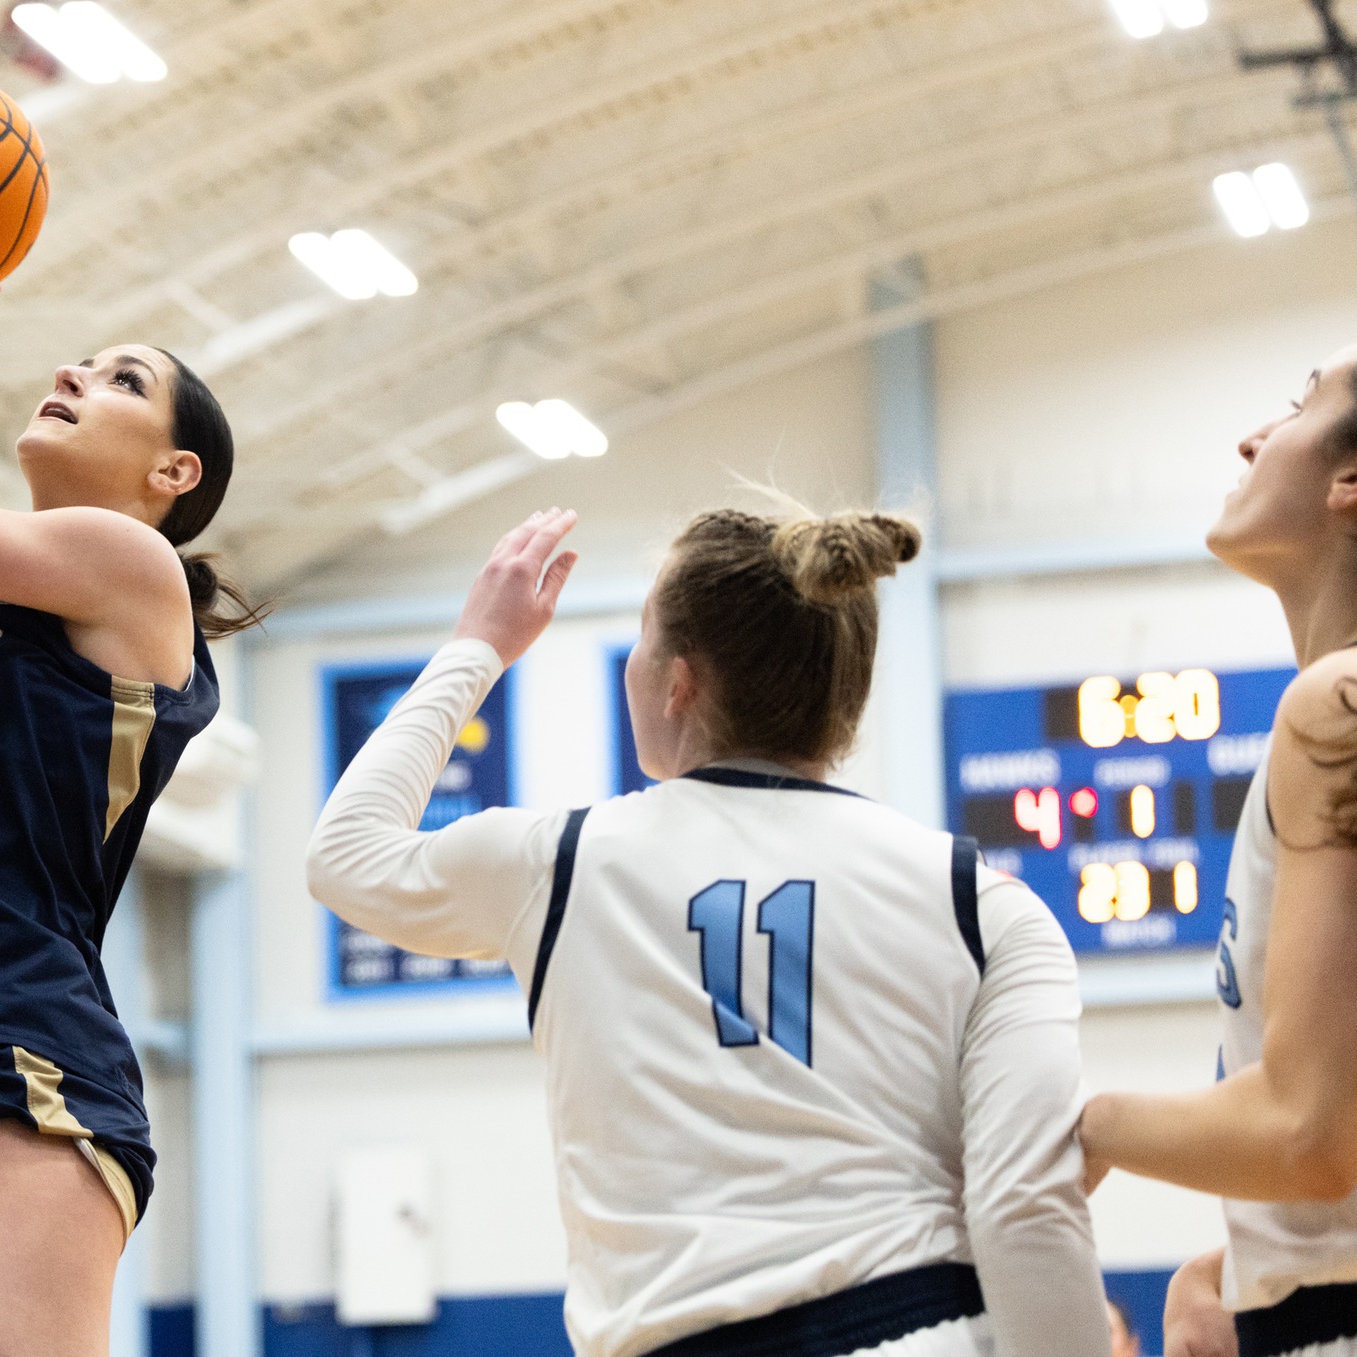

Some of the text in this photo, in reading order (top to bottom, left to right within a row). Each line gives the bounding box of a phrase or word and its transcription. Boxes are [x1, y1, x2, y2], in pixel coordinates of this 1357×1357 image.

[1078, 668, 1221, 748] 6:20
[1014, 786, 1062, 849] 4
[687, 879, 816, 1069] 11
